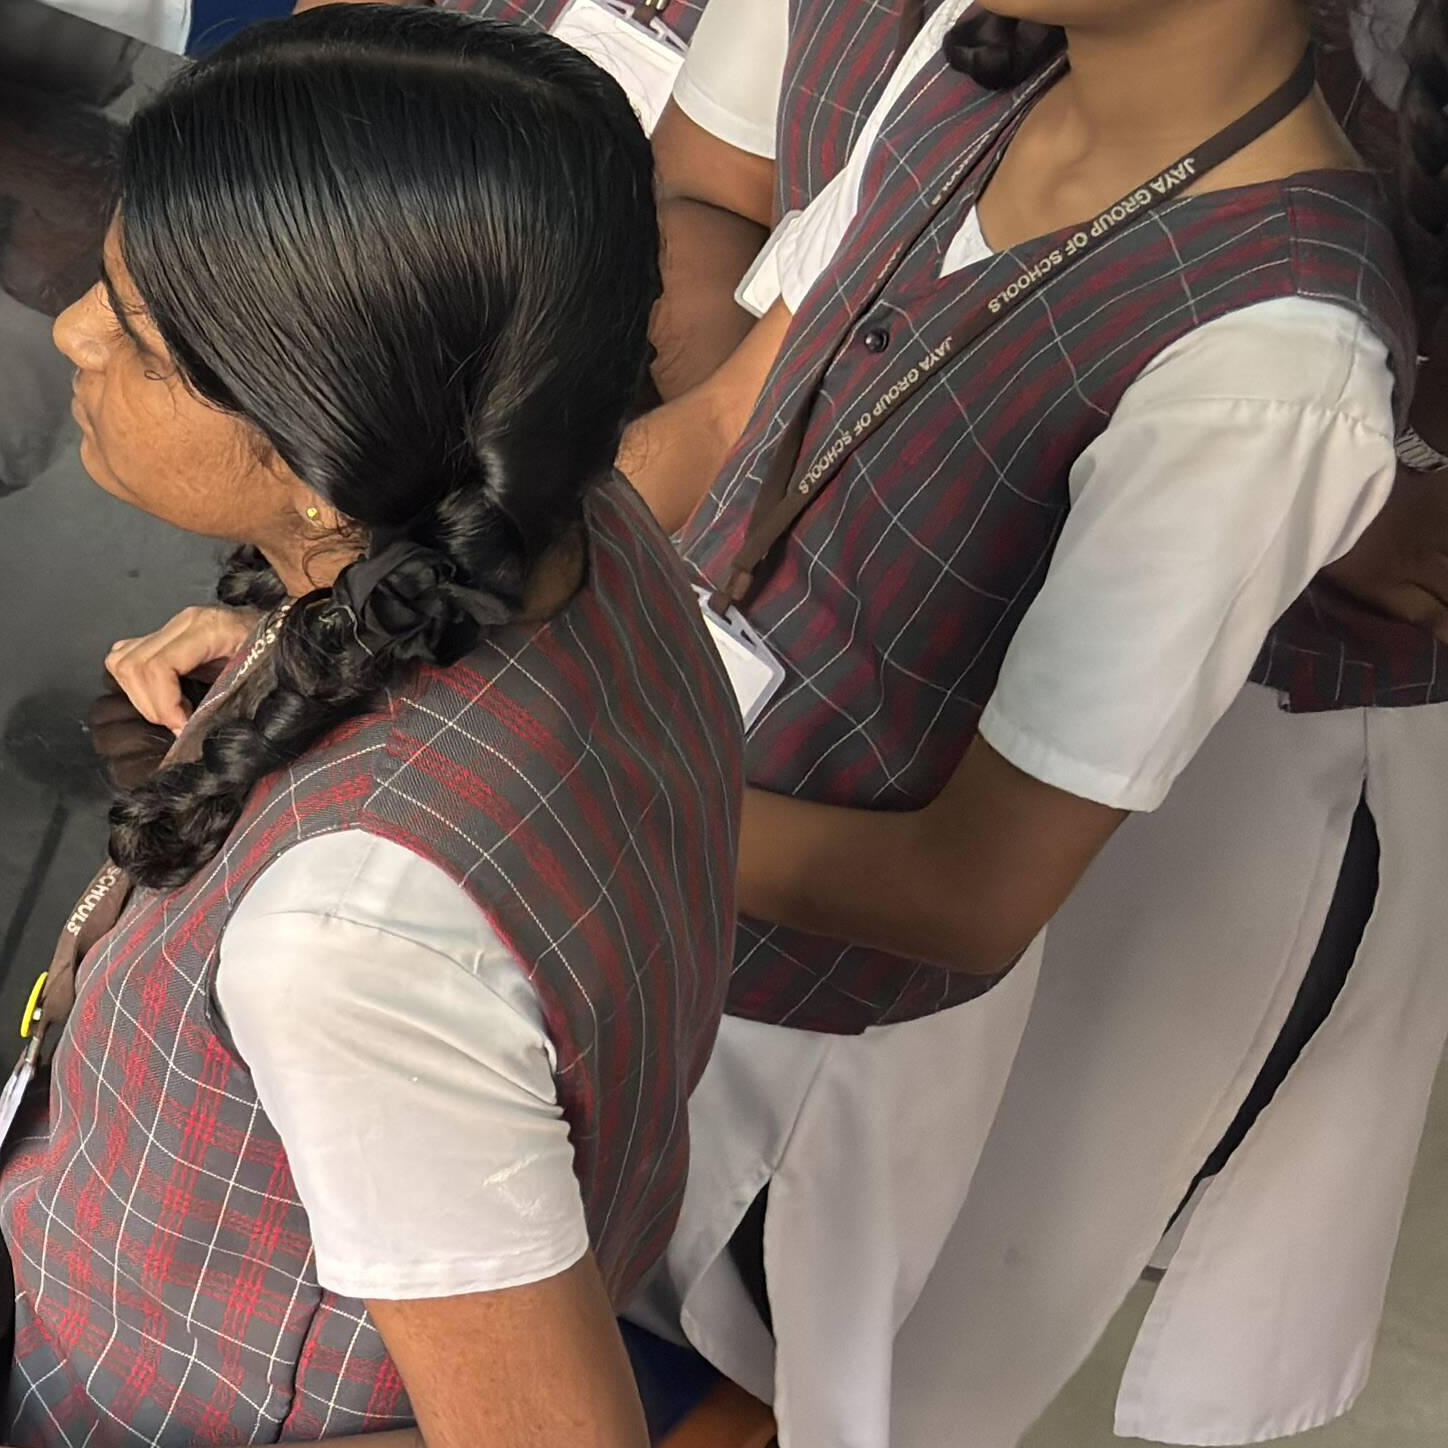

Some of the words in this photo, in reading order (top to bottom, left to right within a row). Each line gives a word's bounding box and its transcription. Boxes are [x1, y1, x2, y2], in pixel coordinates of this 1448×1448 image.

[1149, 156, 1197, 197] JAYA
[1086, 182, 1154, 236] GROUP
[1054, 226, 1090, 256] OF
[986, 247, 1063, 315] SCHOOLS
[917, 336, 955, 378] JAYA
[872, 365, 923, 425] GROUP
[851, 413, 876, 446] OF
[798, 430, 858, 496] SCHOOLS
